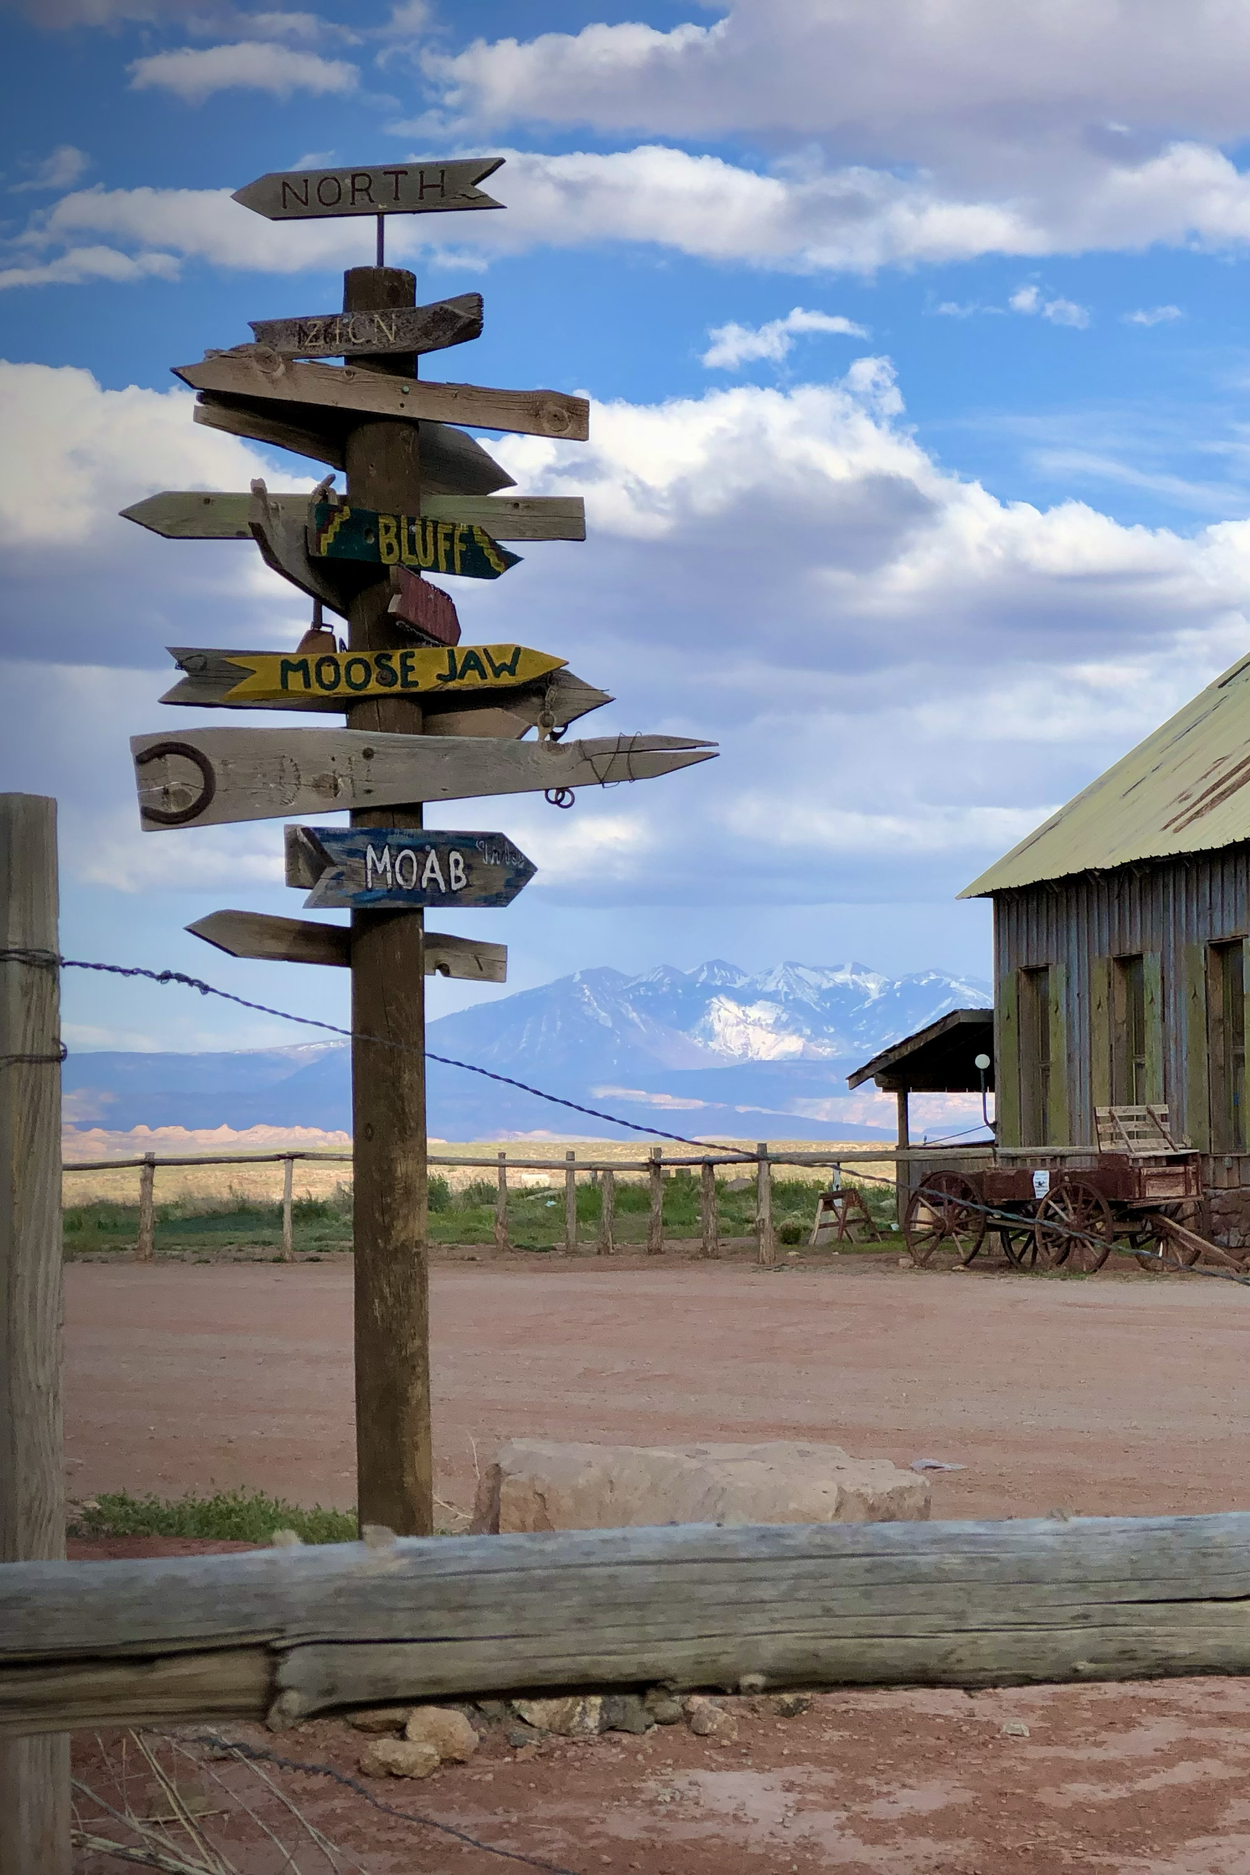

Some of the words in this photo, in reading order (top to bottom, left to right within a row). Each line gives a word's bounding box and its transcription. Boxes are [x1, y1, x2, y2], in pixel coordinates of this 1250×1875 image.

[281, 169, 446, 209] NORTH
[378, 514, 469, 574] BLUFF
[279, 650, 420, 691] MOOSE
[436, 646, 521, 683] JAW
[365, 843, 467, 894] MOAB
